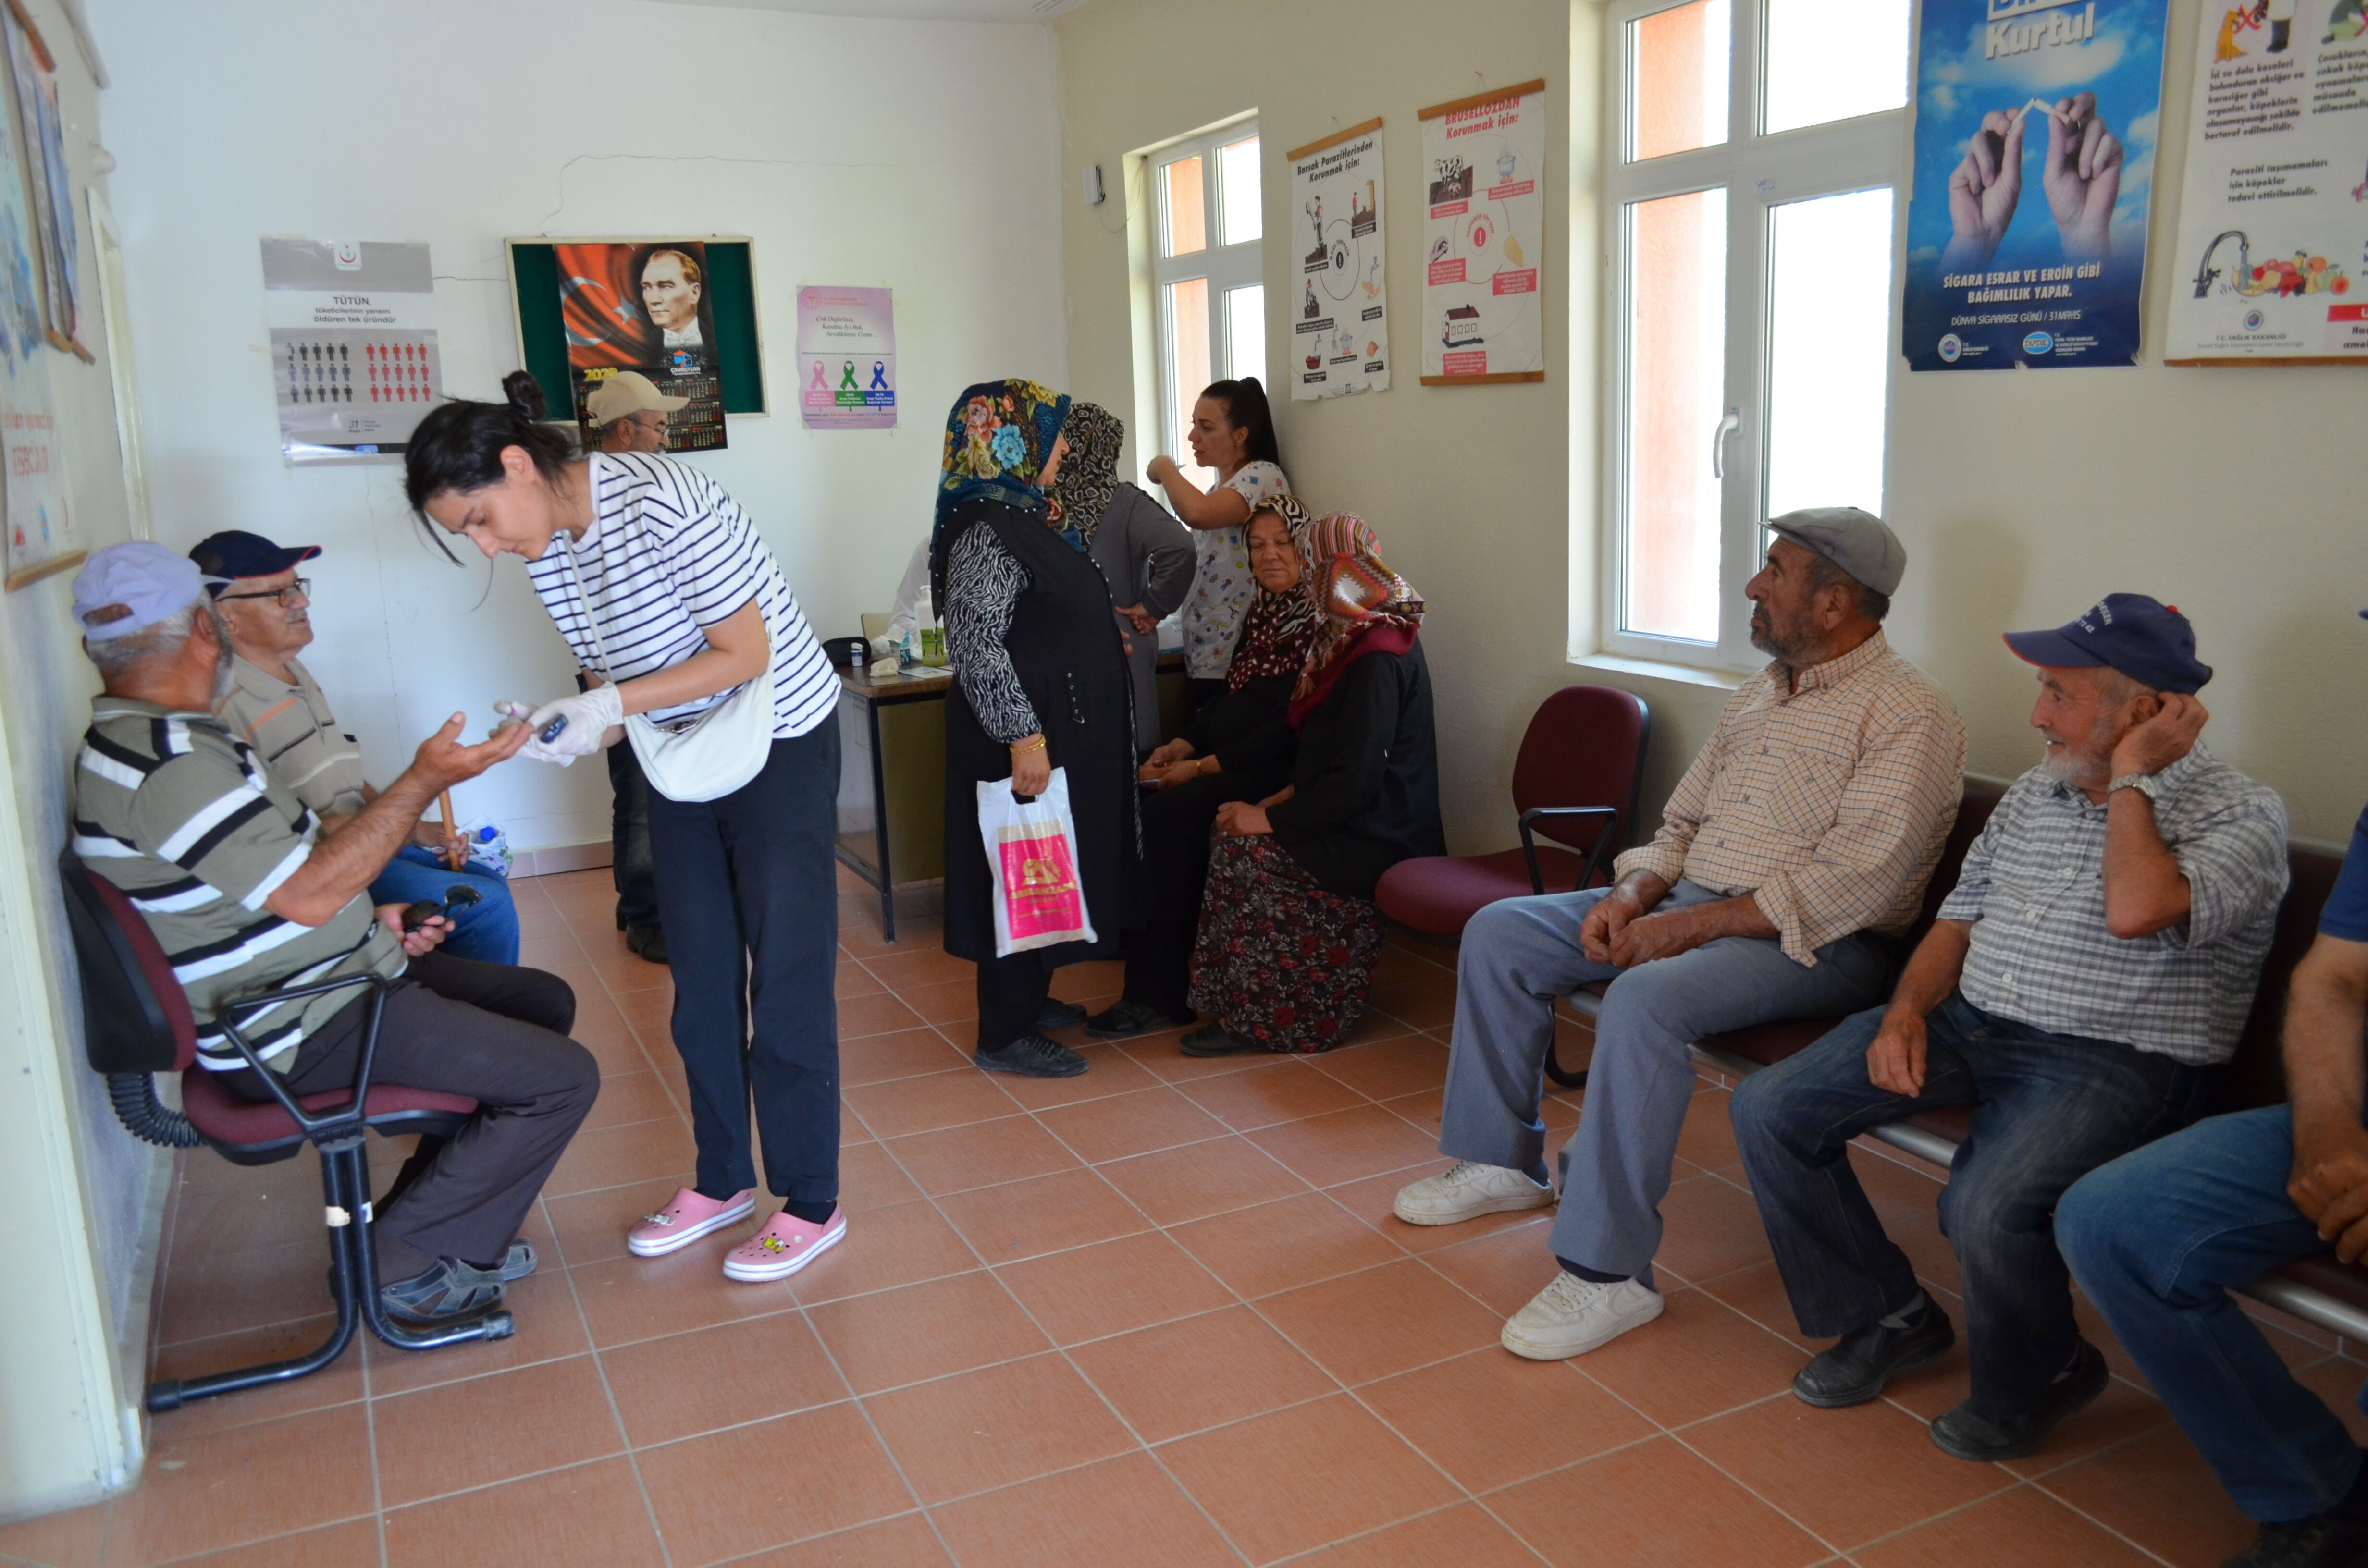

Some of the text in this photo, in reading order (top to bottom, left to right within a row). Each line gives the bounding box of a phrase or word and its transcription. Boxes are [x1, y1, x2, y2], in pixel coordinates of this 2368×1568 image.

[1986, 3, 2095, 61] Kurtul
[2210, 69, 2220, 80] İçi
[2235, 65, 2254, 76] dolu
[2257, 59, 2294, 72] keseleri
[2316, 64, 2344, 76] sokak
[2209, 79, 2257, 91] bulunduran
[2260, 73, 2292, 85] akciğer
[2208, 87, 2268, 104] karaciğer gibi
[2313, 89, 2357, 102] müsaade
[2207, 97, 2298, 117] organlar, köpeklerin
[1446, 112, 1519, 140] Korunmak için:
[2206, 113, 2268, 129] ulaşamayacağı
[2204, 122, 2294, 140] bertaraf edilmelidir.
[1297, 141, 1373, 176] Barsak Parazitlerinden
[1309, 158, 1360, 183] Korunmak için:
[2230, 159, 2328, 176] Paraziti taşımamaları
[2229, 177, 2286, 190] için köpekler
[2228, 187, 2318, 203] tedavi ettirilmelidir.
[1943, 261, 2101, 289] SİGARA ESRAR VE EROİN GİBİ
[1967, 284, 2072, 304] BAĞIMLILIK YAPAR.
[1951, 314, 1977, 326] DÜNYA
[1977, 312, 2018, 325] SİGARASIZ
[2020, 310, 2043, 323] GÜNÜ
[2023, 339, 2048, 348] TAPDK
[349, 420, 358, 429] 31
